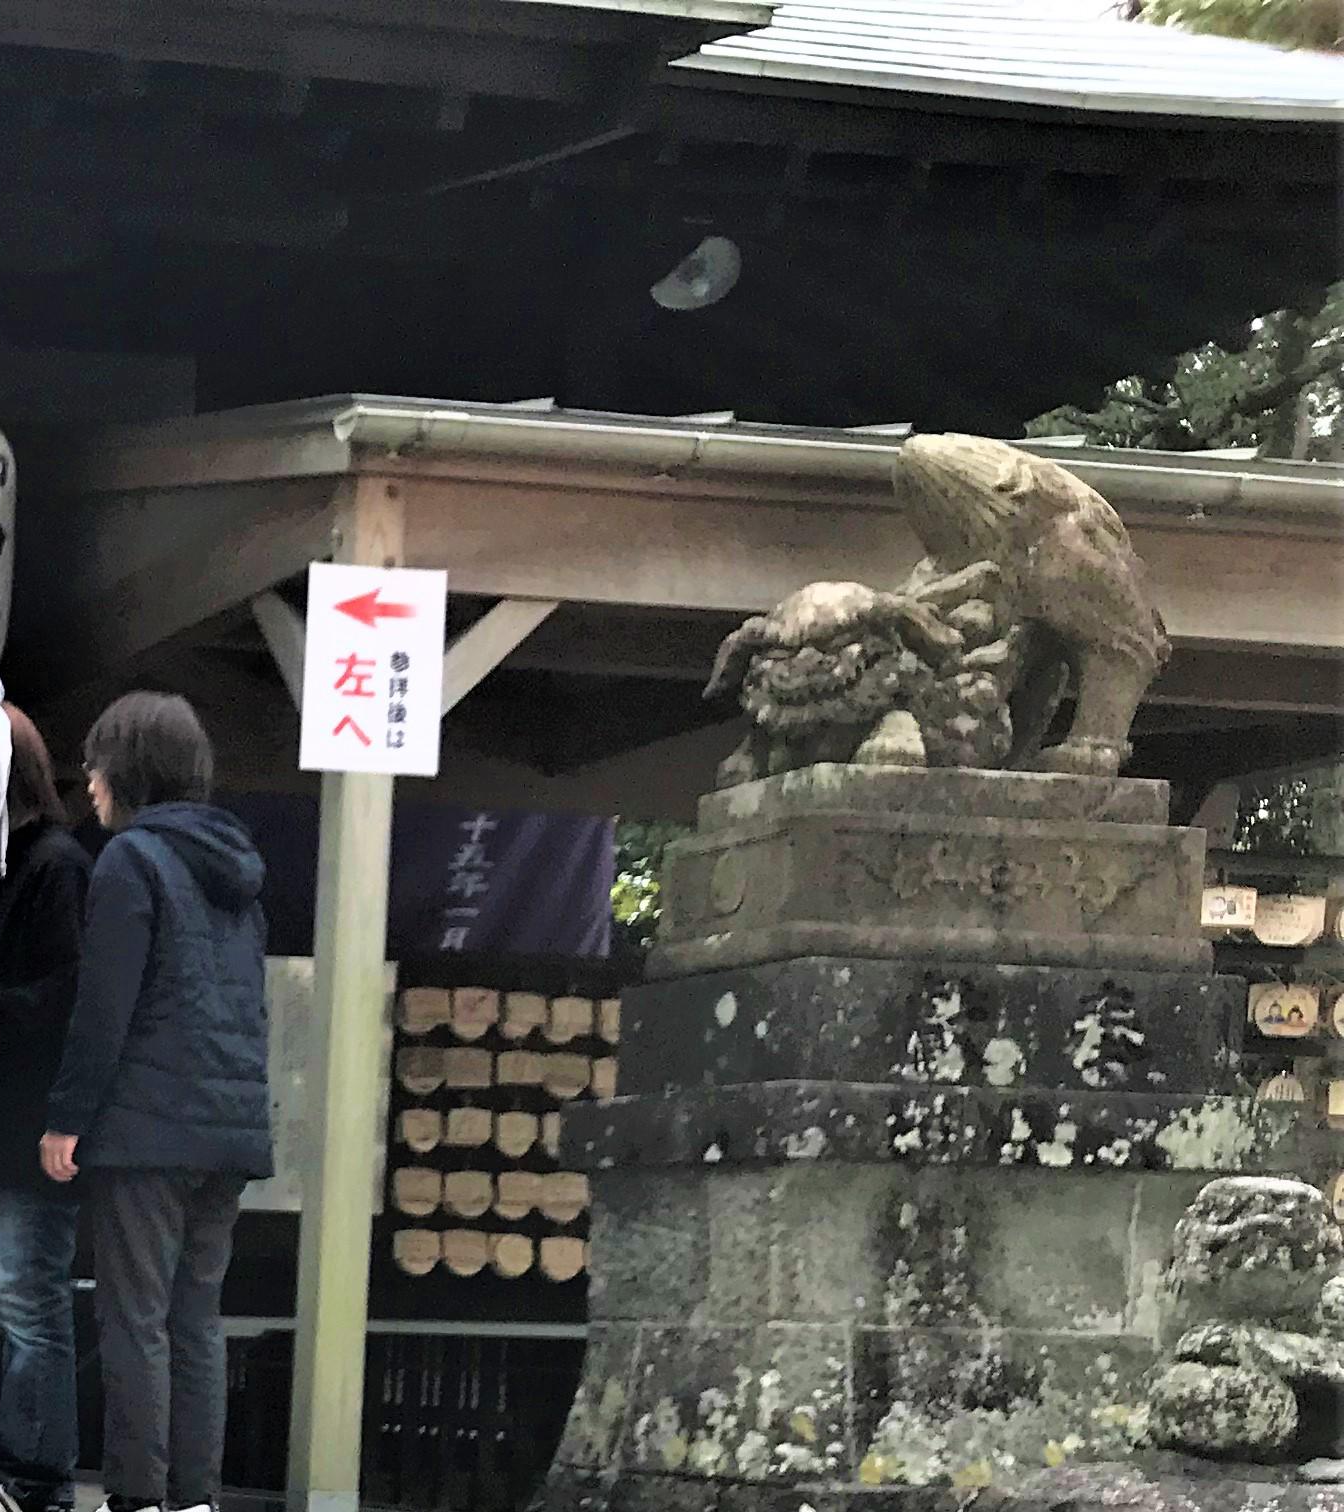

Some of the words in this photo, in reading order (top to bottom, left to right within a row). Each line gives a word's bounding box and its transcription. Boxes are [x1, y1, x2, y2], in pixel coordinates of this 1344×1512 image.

[332, 652, 376, 747] 左へ
[386, 651, 410, 749] 参拝後は
